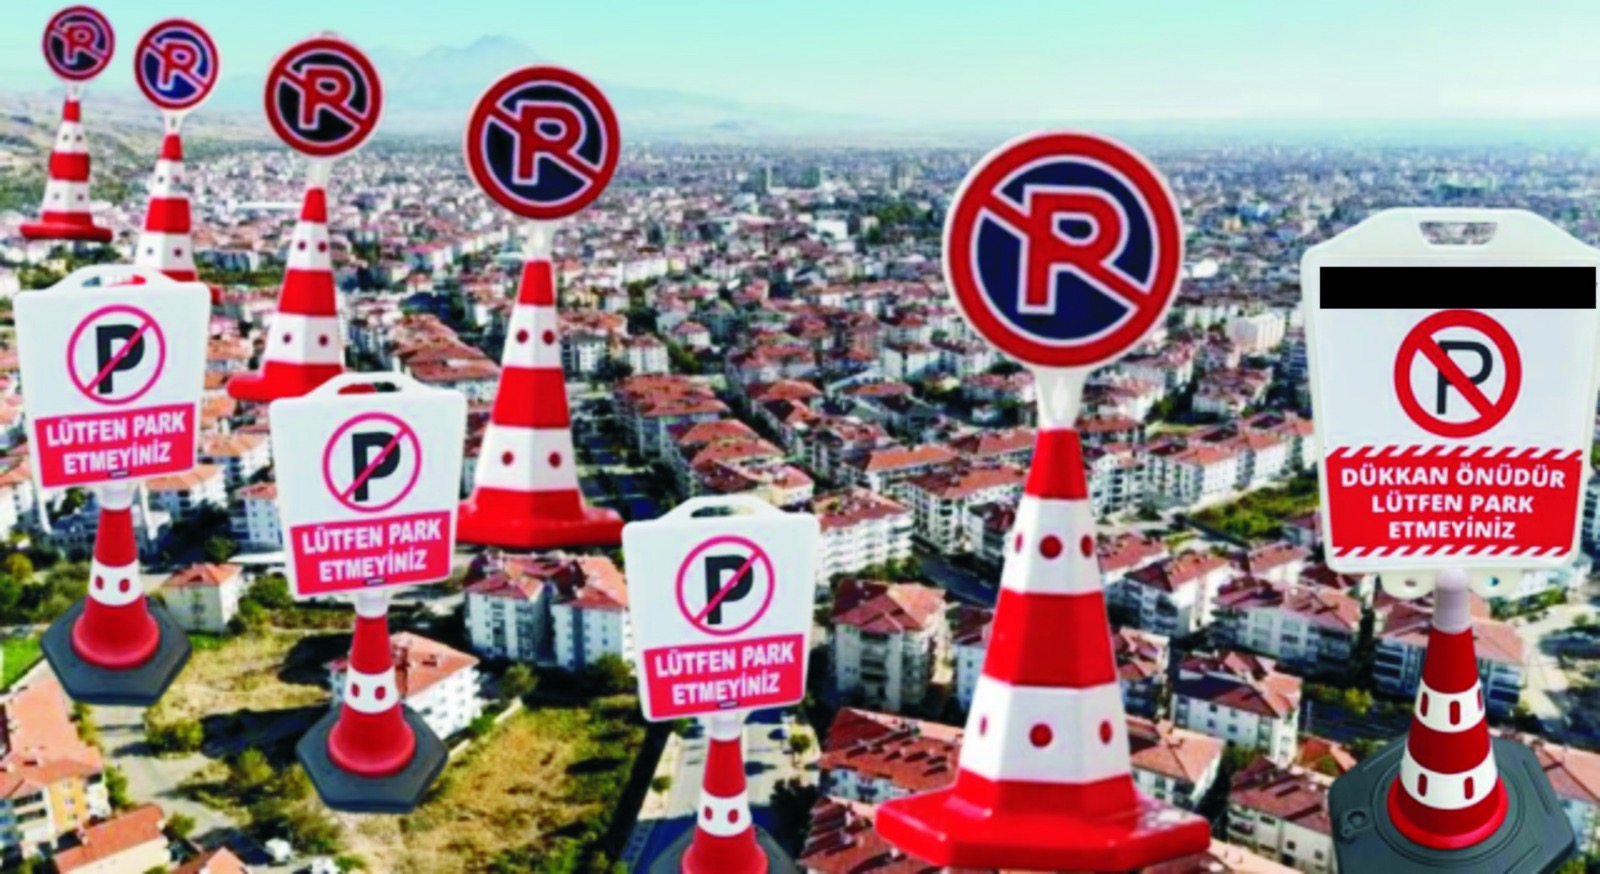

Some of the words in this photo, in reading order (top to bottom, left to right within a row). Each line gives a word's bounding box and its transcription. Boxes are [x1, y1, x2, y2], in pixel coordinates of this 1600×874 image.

[96, 324, 145, 394] P
[46, 418, 127, 447] LÜTFEN
[133, 411, 186, 438] PARK
[63, 441, 171, 475] ETMEYİNİZ
[352, 431, 400, 502] P
[1341, 462, 1449, 487] DÜKKAN
[1455, 463, 1566, 488] ÖNÜDÜR
[1371, 491, 1463, 513] LÜTFEN
[1470, 496, 1534, 514] PARK
[302, 526, 383, 555] LÜTFEN
[389, 519, 442, 545] PARK
[1388, 516, 1516, 539] ETMEYİNİZ
[319, 547, 427, 582] ETMEYİNİZ
[705, 554, 754, 625] P
[655, 650, 735, 677] LÜTFEN
[742, 642, 795, 669] PARK
[672, 671, 780, 705] ETMEYİNİZ
